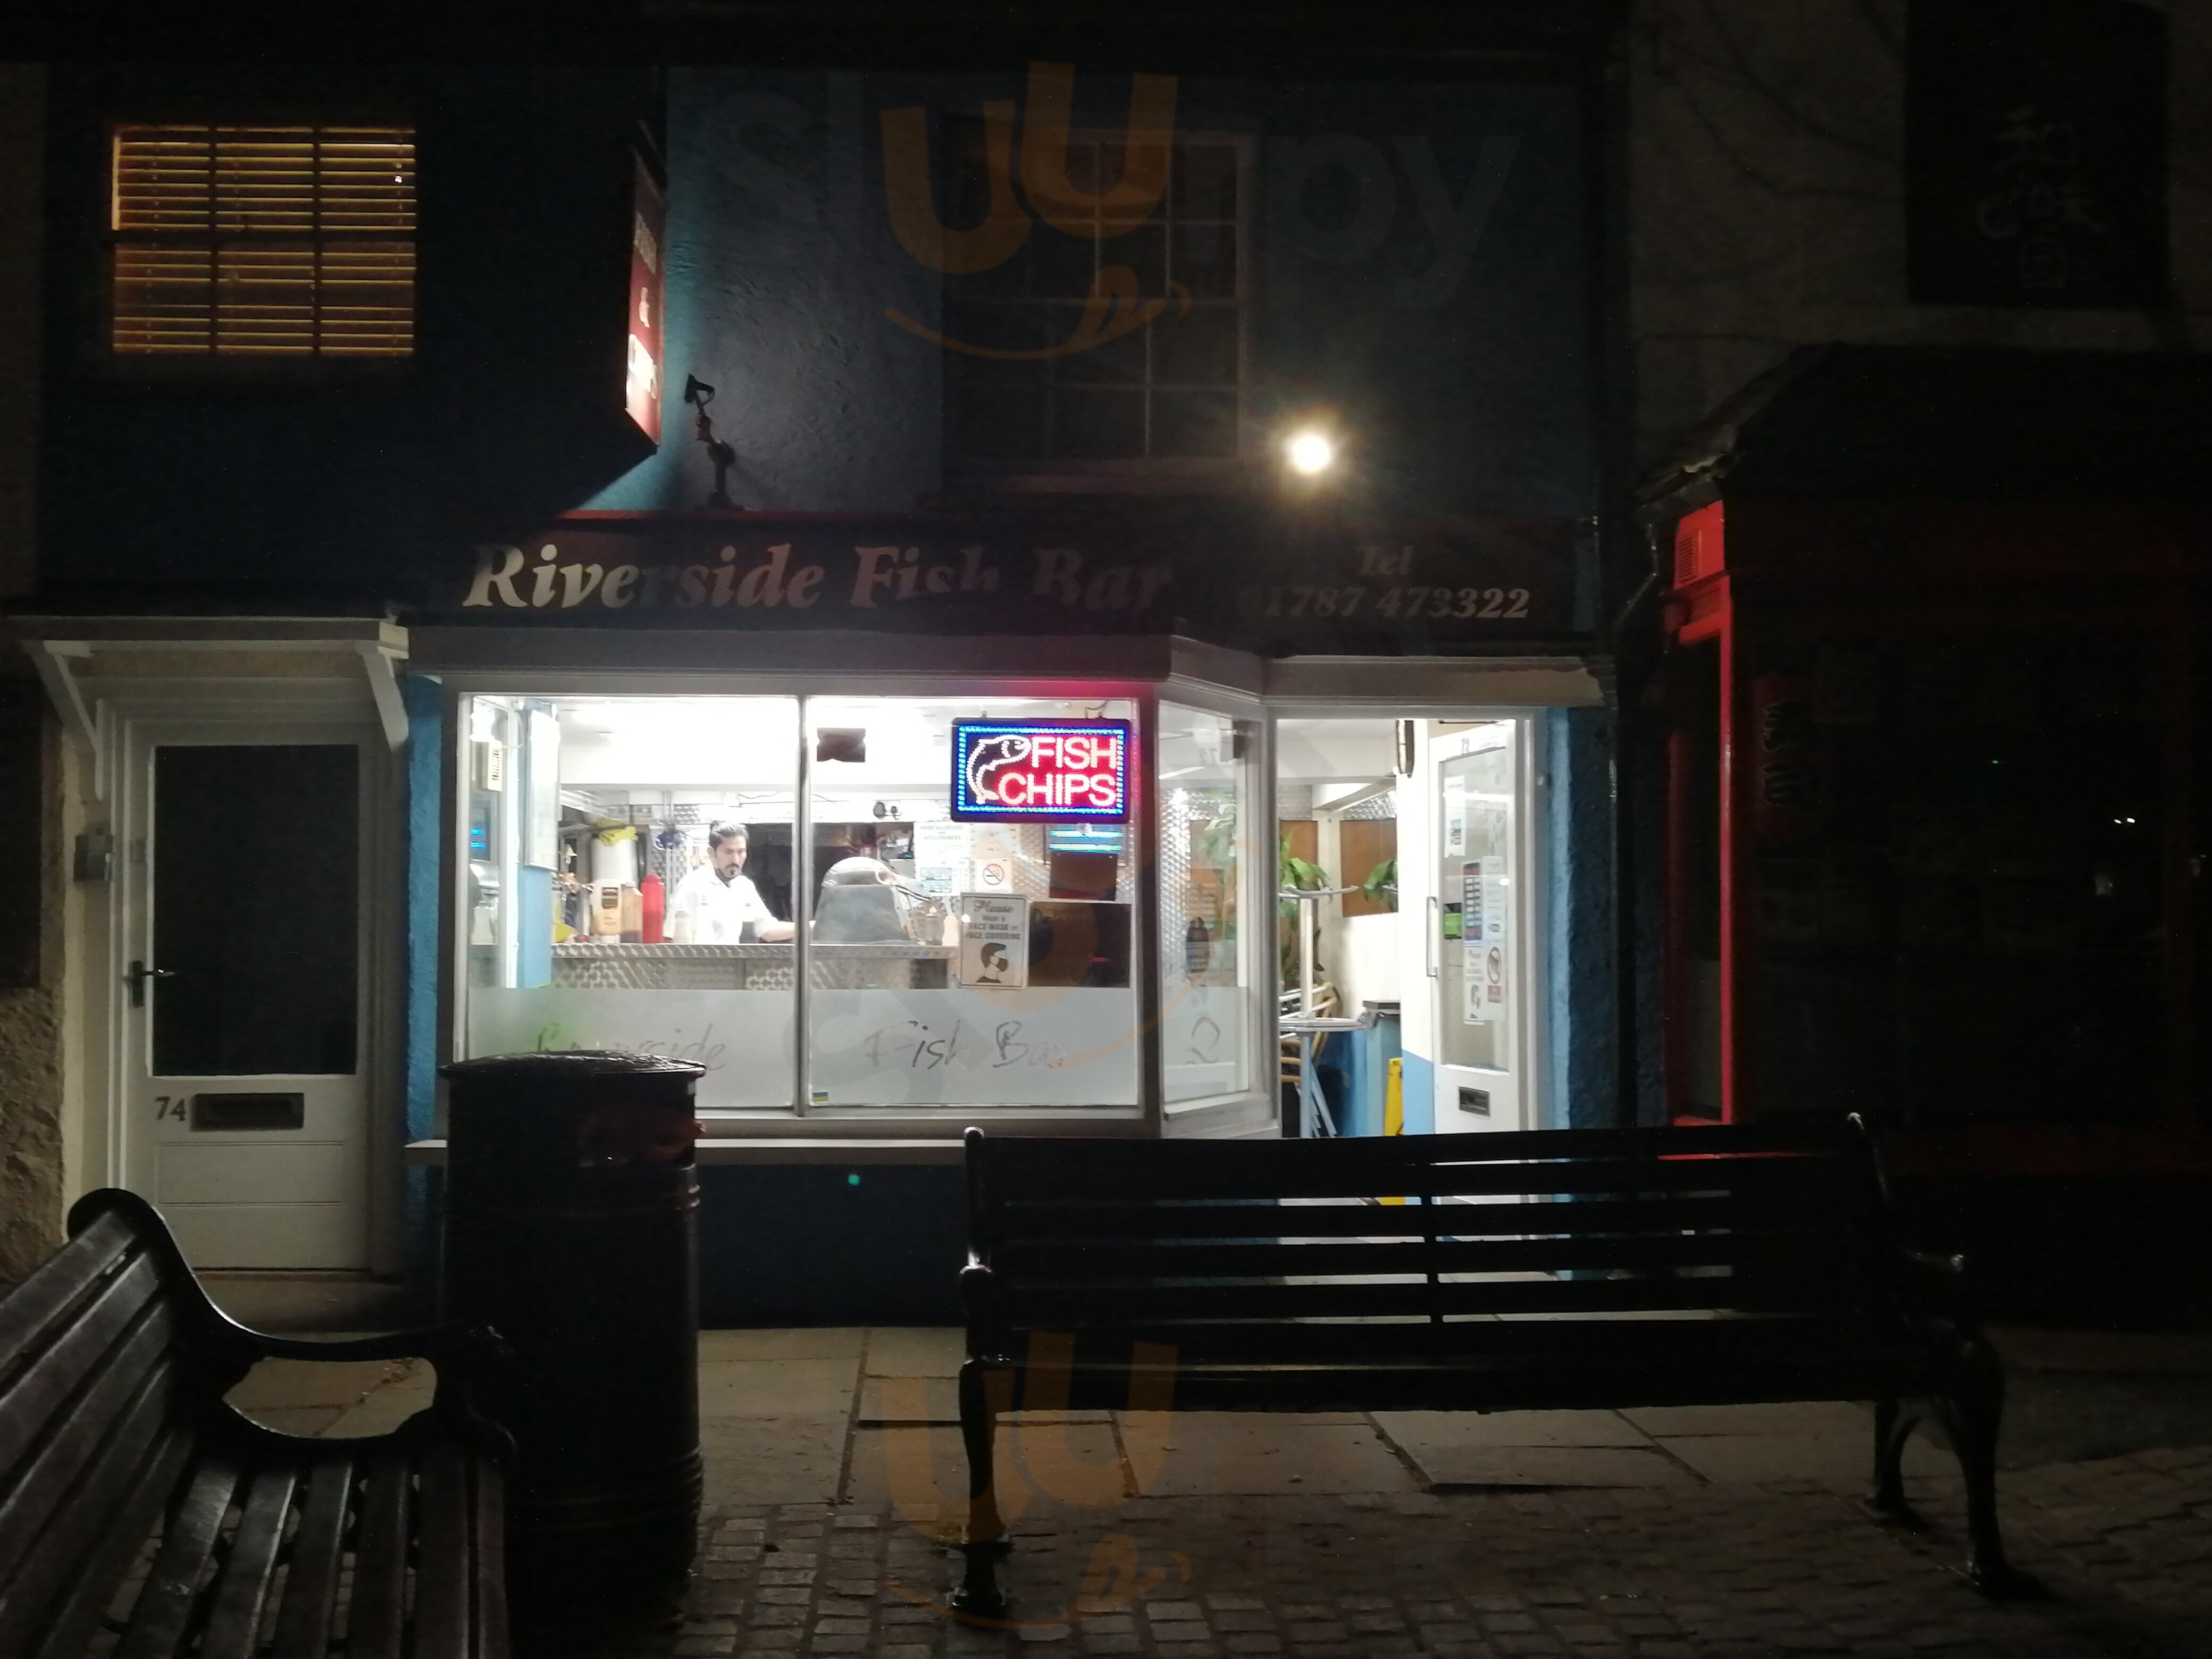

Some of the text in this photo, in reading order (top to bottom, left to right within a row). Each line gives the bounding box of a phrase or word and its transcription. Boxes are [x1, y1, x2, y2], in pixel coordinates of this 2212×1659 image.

[1356, 544, 1413, 576] Tel
[462, 543, 1171, 613] Riverside Fish Bar
[1375, 586, 1531, 619] 473322
[1031, 736, 1117, 769] FISH
[998, 773, 1117, 807] CHIPS
[973, 900, 1015, 913] Please
[155, 1096, 187, 1121] 74
